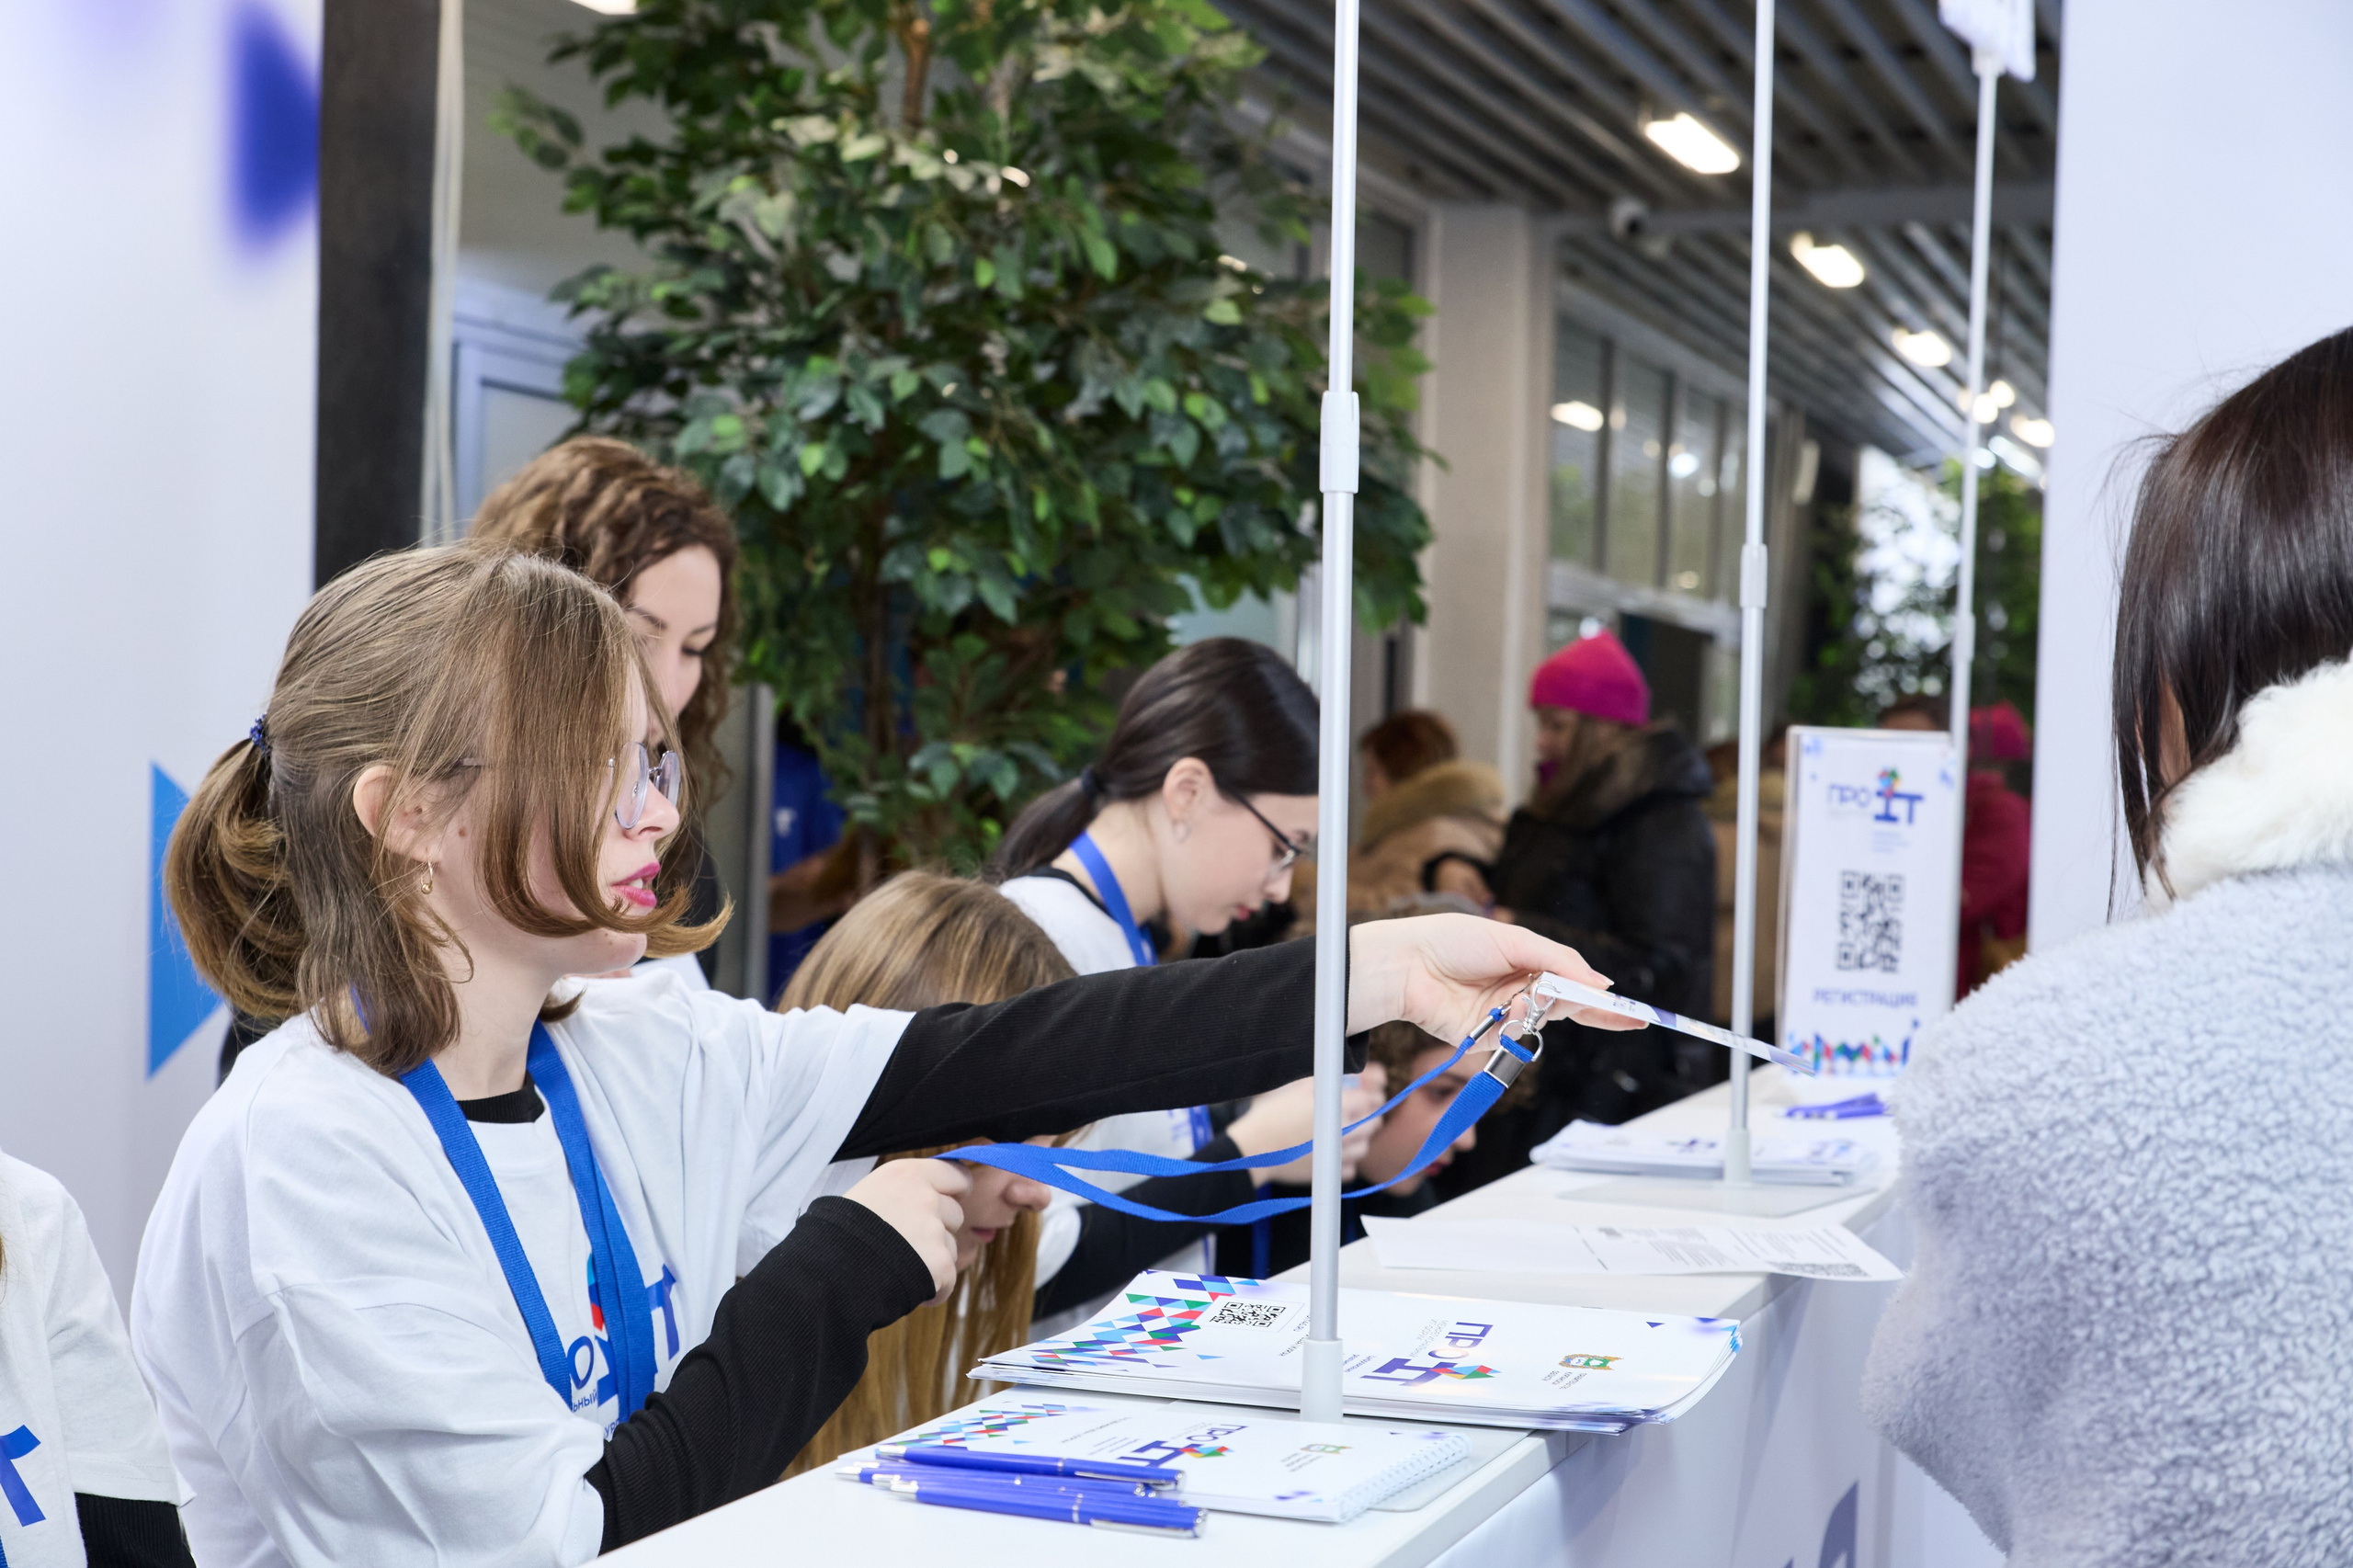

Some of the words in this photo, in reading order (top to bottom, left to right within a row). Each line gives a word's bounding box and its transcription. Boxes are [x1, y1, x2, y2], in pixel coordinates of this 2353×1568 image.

[1827, 783, 1872, 808] ПРО
[1873, 789, 1925, 825] IT
[1427, 1321, 1495, 1360] ПРО
[1186, 1424, 1249, 1442] ПРО
